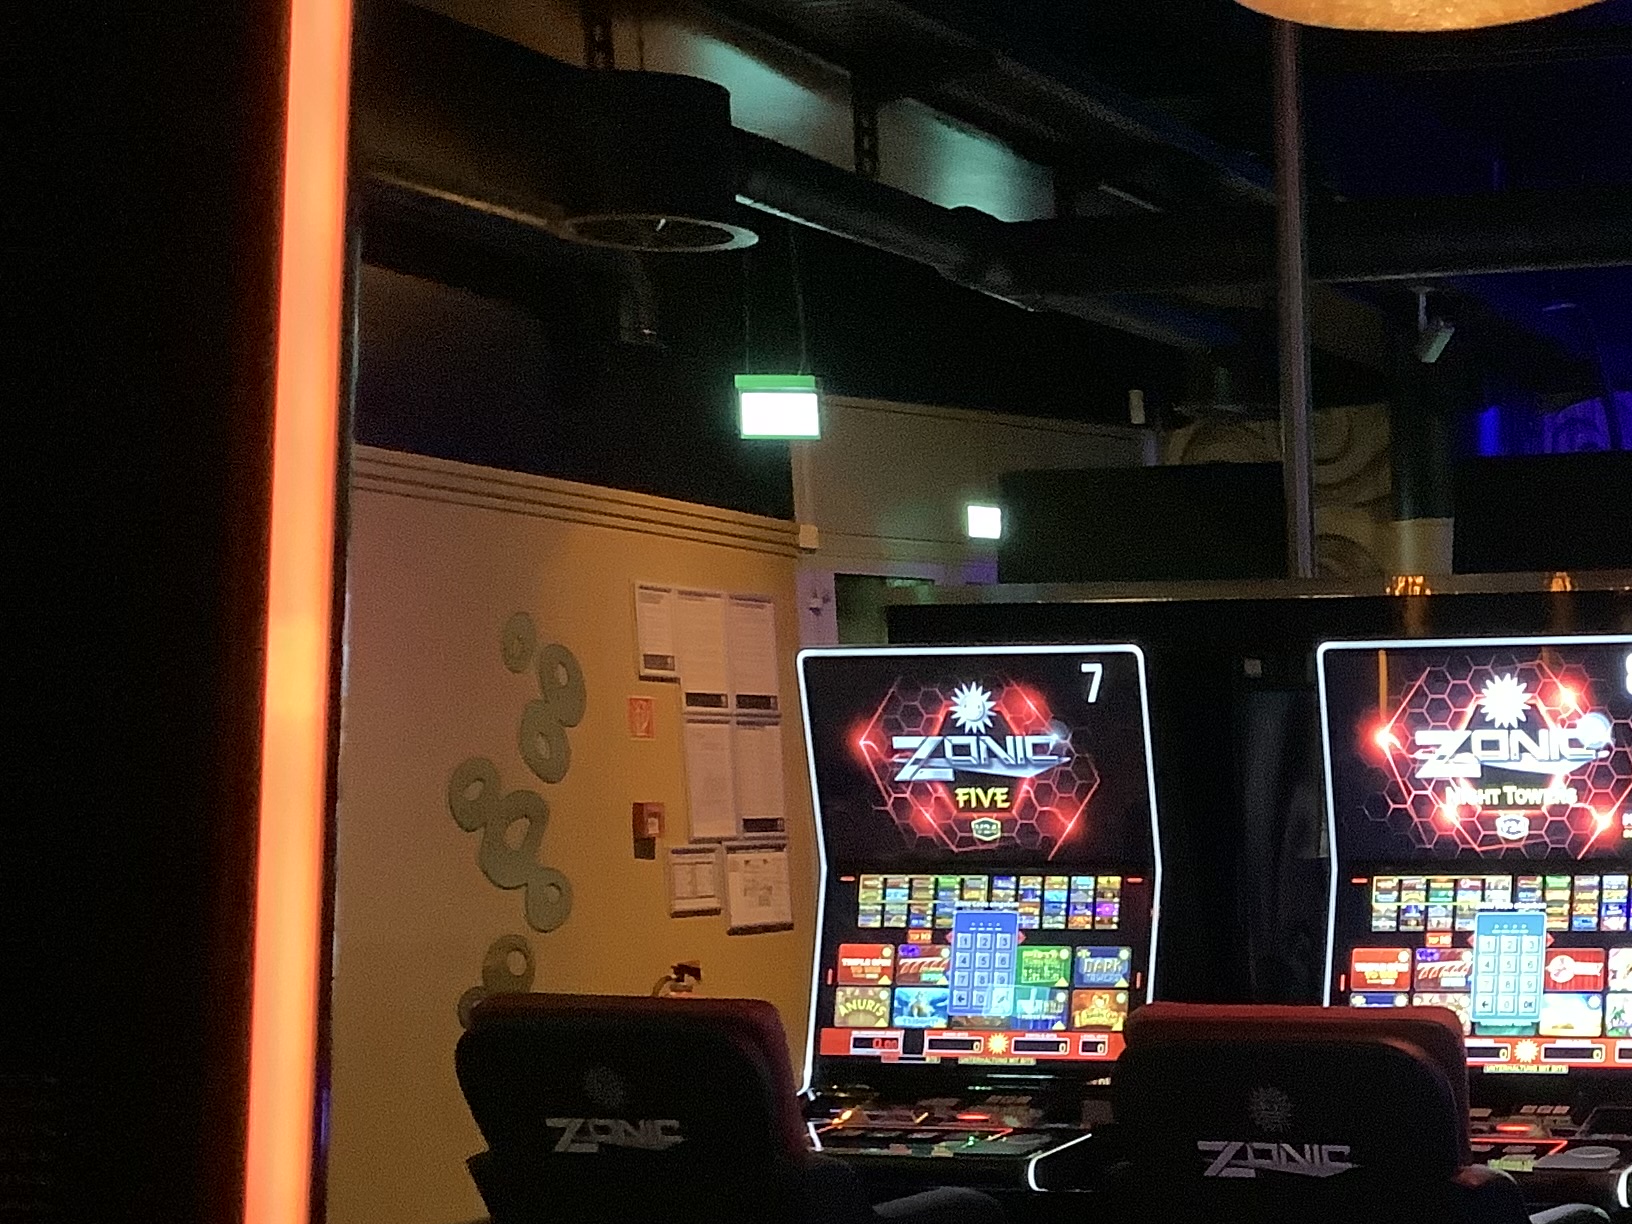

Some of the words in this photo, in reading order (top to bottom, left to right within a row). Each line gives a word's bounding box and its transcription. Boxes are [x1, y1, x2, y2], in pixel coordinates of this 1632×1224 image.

[1080, 662, 1104, 703] 7
[892, 734, 1066, 782] ZONIC
[1414, 729, 1602, 779] ZONIC
[954, 786, 1011, 809] FIVE
[838, 998, 887, 1017] ANURIS
[545, 1118, 684, 1153] ZONIC
[1197, 1141, 1360, 1178] ZONIC
